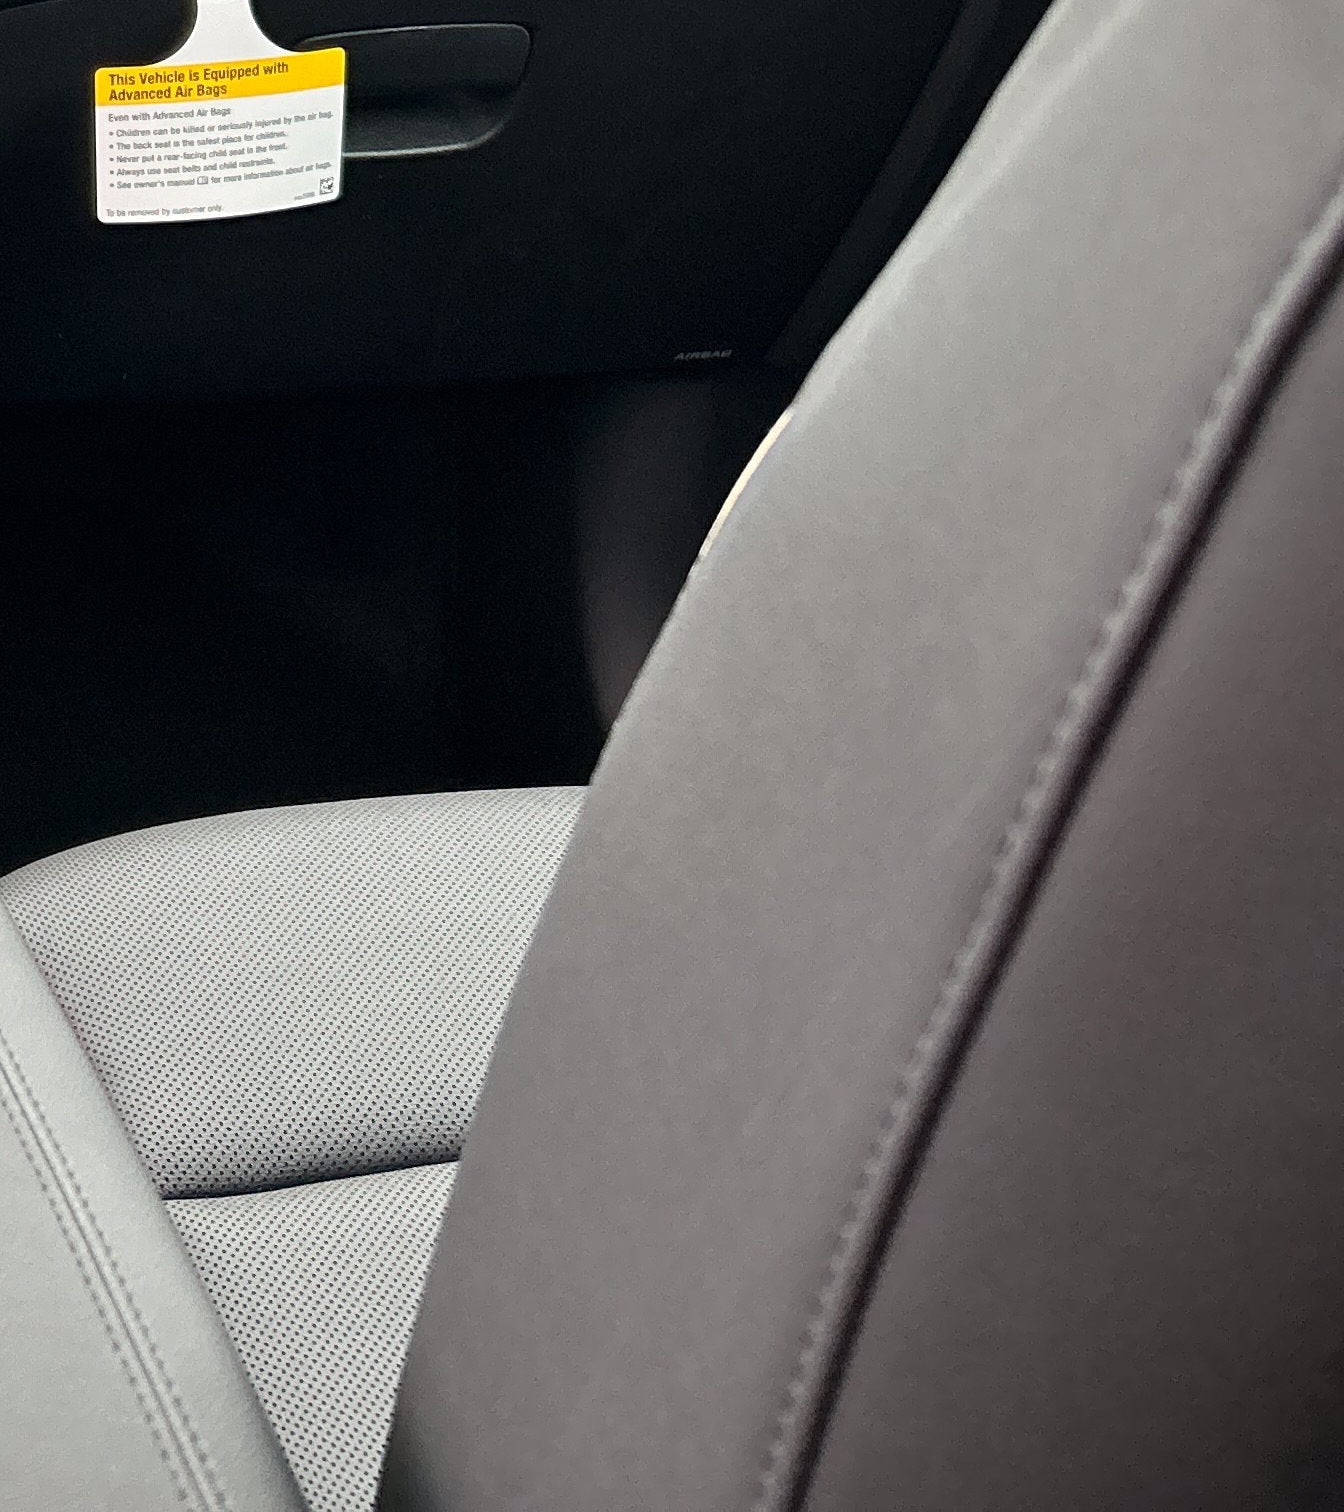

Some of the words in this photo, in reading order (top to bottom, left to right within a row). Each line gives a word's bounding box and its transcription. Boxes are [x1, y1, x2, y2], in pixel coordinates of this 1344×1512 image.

[109, 74, 135, 86] This
[139, 71, 185, 85] Vehicle
[203, 64, 260, 82] Equipped
[263, 62, 289, 75] with
[108, 86, 171, 101] Advanced
[175, 85, 193, 98] Air
[197, 84, 228, 98] Bags
[108, 113, 129, 123] Even
[132, 112, 151, 121] with
[153, 109, 194, 120] Advanced
[196, 108, 209, 117] Air
[211, 107, 231, 117] Bags
[116, 128, 151, 137] Children
[153, 128, 168, 136] can
[171, 126, 180, 134] be
[284, 116, 292, 125] by
[116, 142, 131, 151] The
[133, 140, 153, 150] back
[182, 138, 194, 147] the
[116, 155, 140, 163] Never
[164, 151, 207, 161] rear-facing
[116, 167, 145, 177] Always
[147, 167, 161, 175] use
[182, 164, 202, 173] belts
[116, 180, 132, 189] See
[106, 208, 115, 217] To
[116, 209, 126, 217] be
[162, 207, 171, 217] by
[673, 349, 732, 361] AIRBAG
